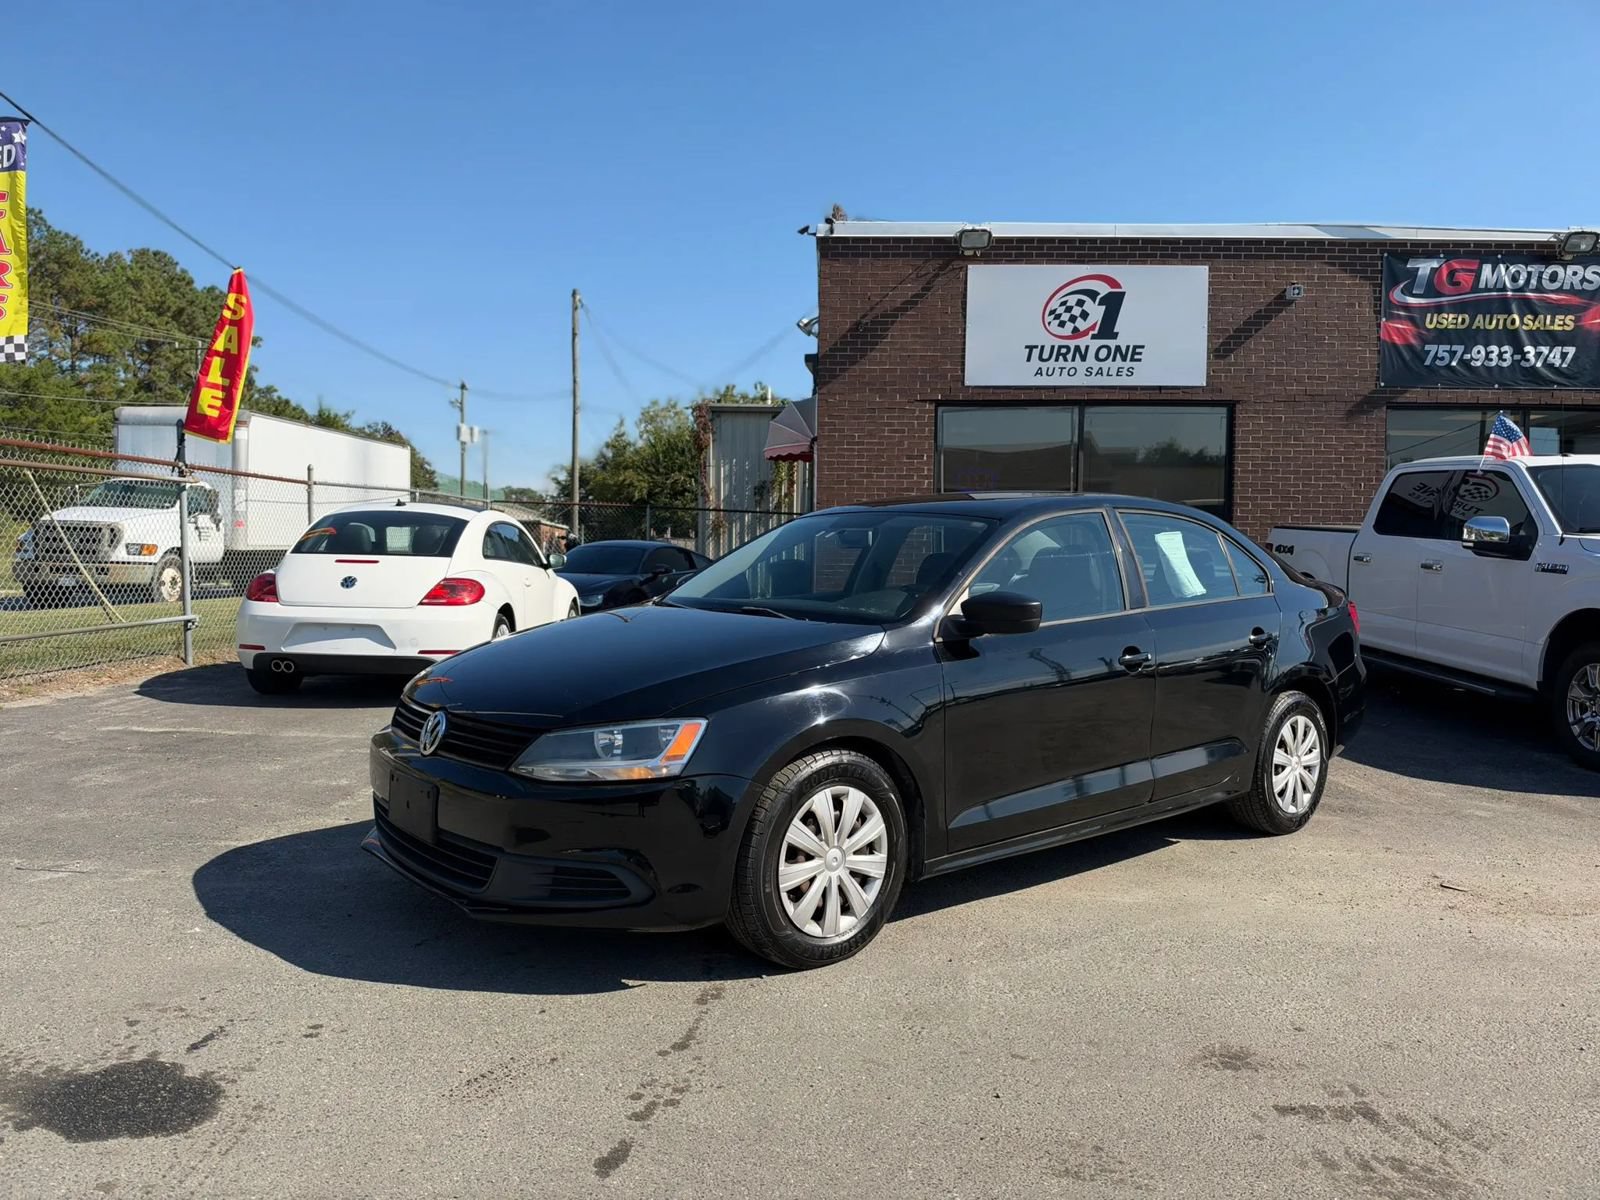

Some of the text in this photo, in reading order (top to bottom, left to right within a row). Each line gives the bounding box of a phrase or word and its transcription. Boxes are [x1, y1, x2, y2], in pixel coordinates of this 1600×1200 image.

[0, 144, 16, 168] D
[1406, 258, 1600, 295] TG MOTORS
[1424, 313, 1575, 331] USED AUTO SALES
[196, 293, 248, 418] SALE
[1024, 345, 1145, 362] TURN ONE
[1423, 344, 1576, 368] 757-933-3747
[1034, 367, 1135, 377] AUTO SALES
